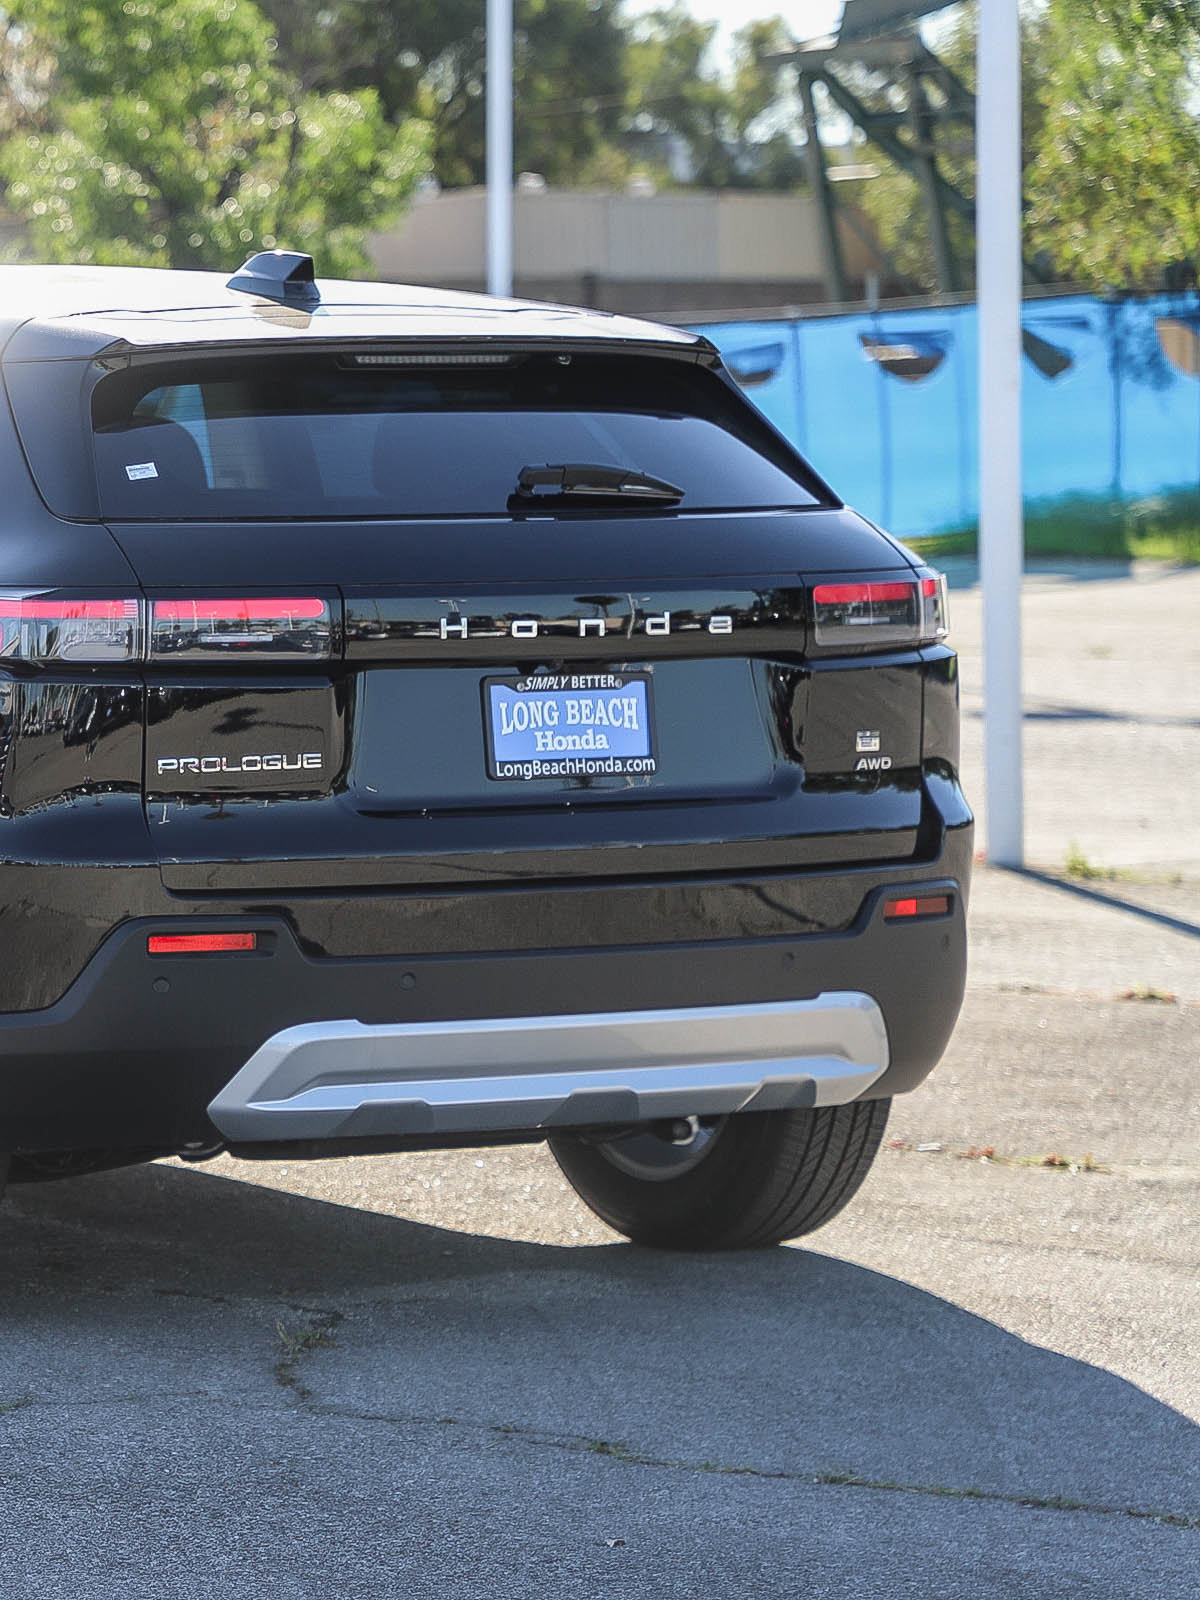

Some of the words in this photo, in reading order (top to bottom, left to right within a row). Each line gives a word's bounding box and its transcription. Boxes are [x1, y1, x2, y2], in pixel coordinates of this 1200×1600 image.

[440, 610, 733, 639] Honda
[524, 676, 569, 690] SIMPLY
[571, 674, 615, 689] BETTER
[499, 699, 560, 735] LONG
[566, 697, 640, 730] BEACH
[534, 729, 609, 752] Honda
[157, 752, 322, 775] PROLOGUE
[496, 756, 656, 780] LongBeachHonda.com
[856, 756, 892, 771] AWD
